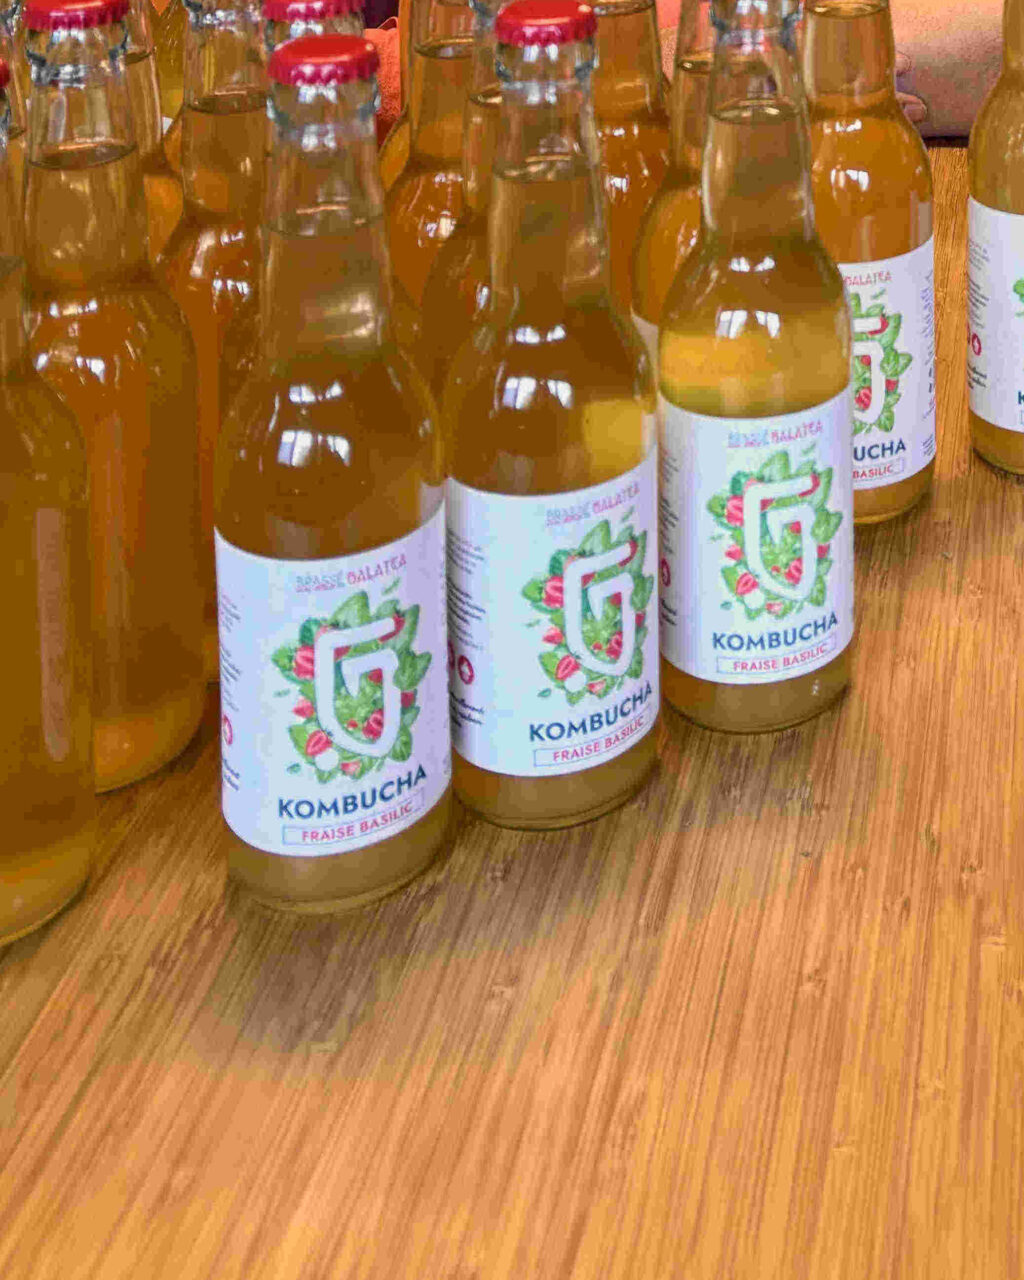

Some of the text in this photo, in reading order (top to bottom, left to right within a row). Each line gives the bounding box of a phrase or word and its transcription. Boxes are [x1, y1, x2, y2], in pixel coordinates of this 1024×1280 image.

[853, 438, 907, 462] UCHA
[852, 464, 894, 480] BASILIC
[712, 611, 839, 652] KOMBUCHA
[732, 644, 828, 672] FRAISE BASILIC
[529, 680, 653, 743] KOMBUCHA
[553, 715, 645, 763] FRAISE BASILIC
[278, 764, 428, 820] KOMBUCHA
[302, 801, 414, 844] FRAISE BASILIC
